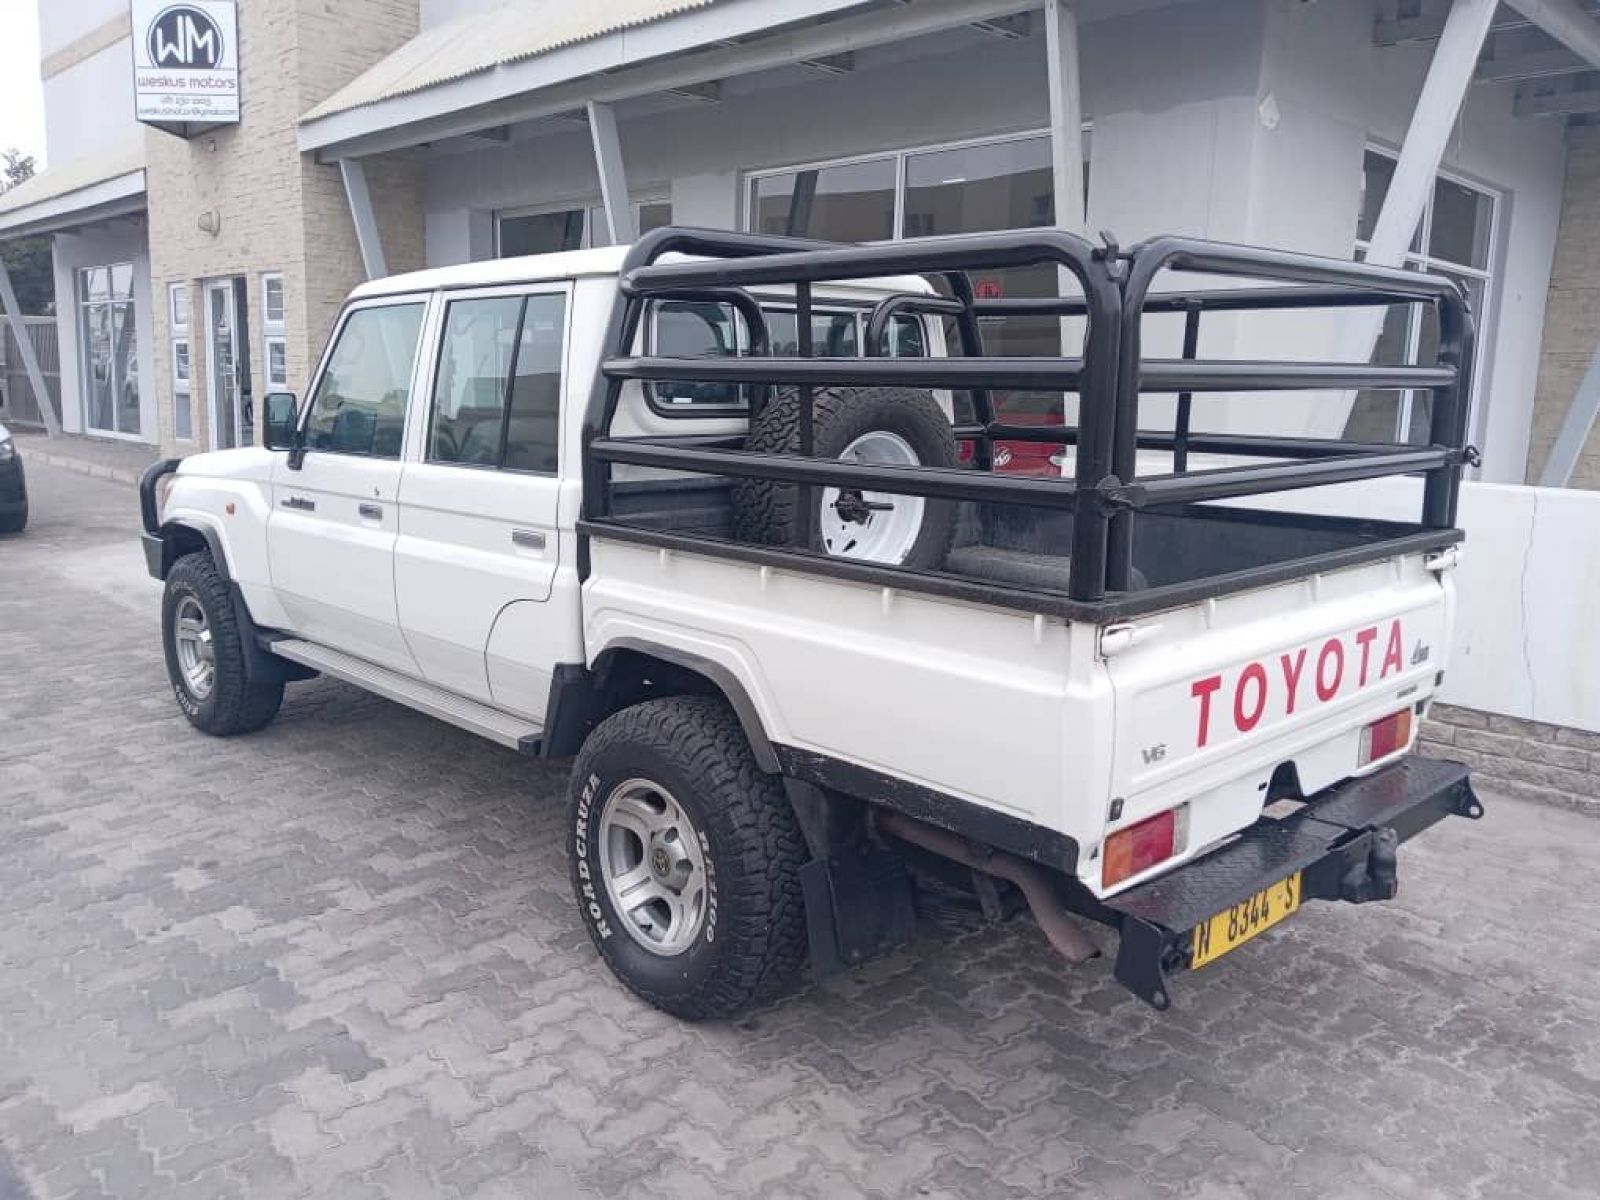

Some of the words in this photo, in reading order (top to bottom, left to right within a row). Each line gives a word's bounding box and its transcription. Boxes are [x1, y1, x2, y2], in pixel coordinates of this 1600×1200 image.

[157, 15, 214, 64] WM
[190, 76, 236, 89] motors
[1191, 618, 1403, 748] TOYOTA
[1142, 743, 1167, 764] V6
[576, 773, 613, 940] ROADCRUZA
[1198, 920, 1211, 959] N
[1228, 889, 1269, 942] 8344
[1285, 873, 1294, 910] S
